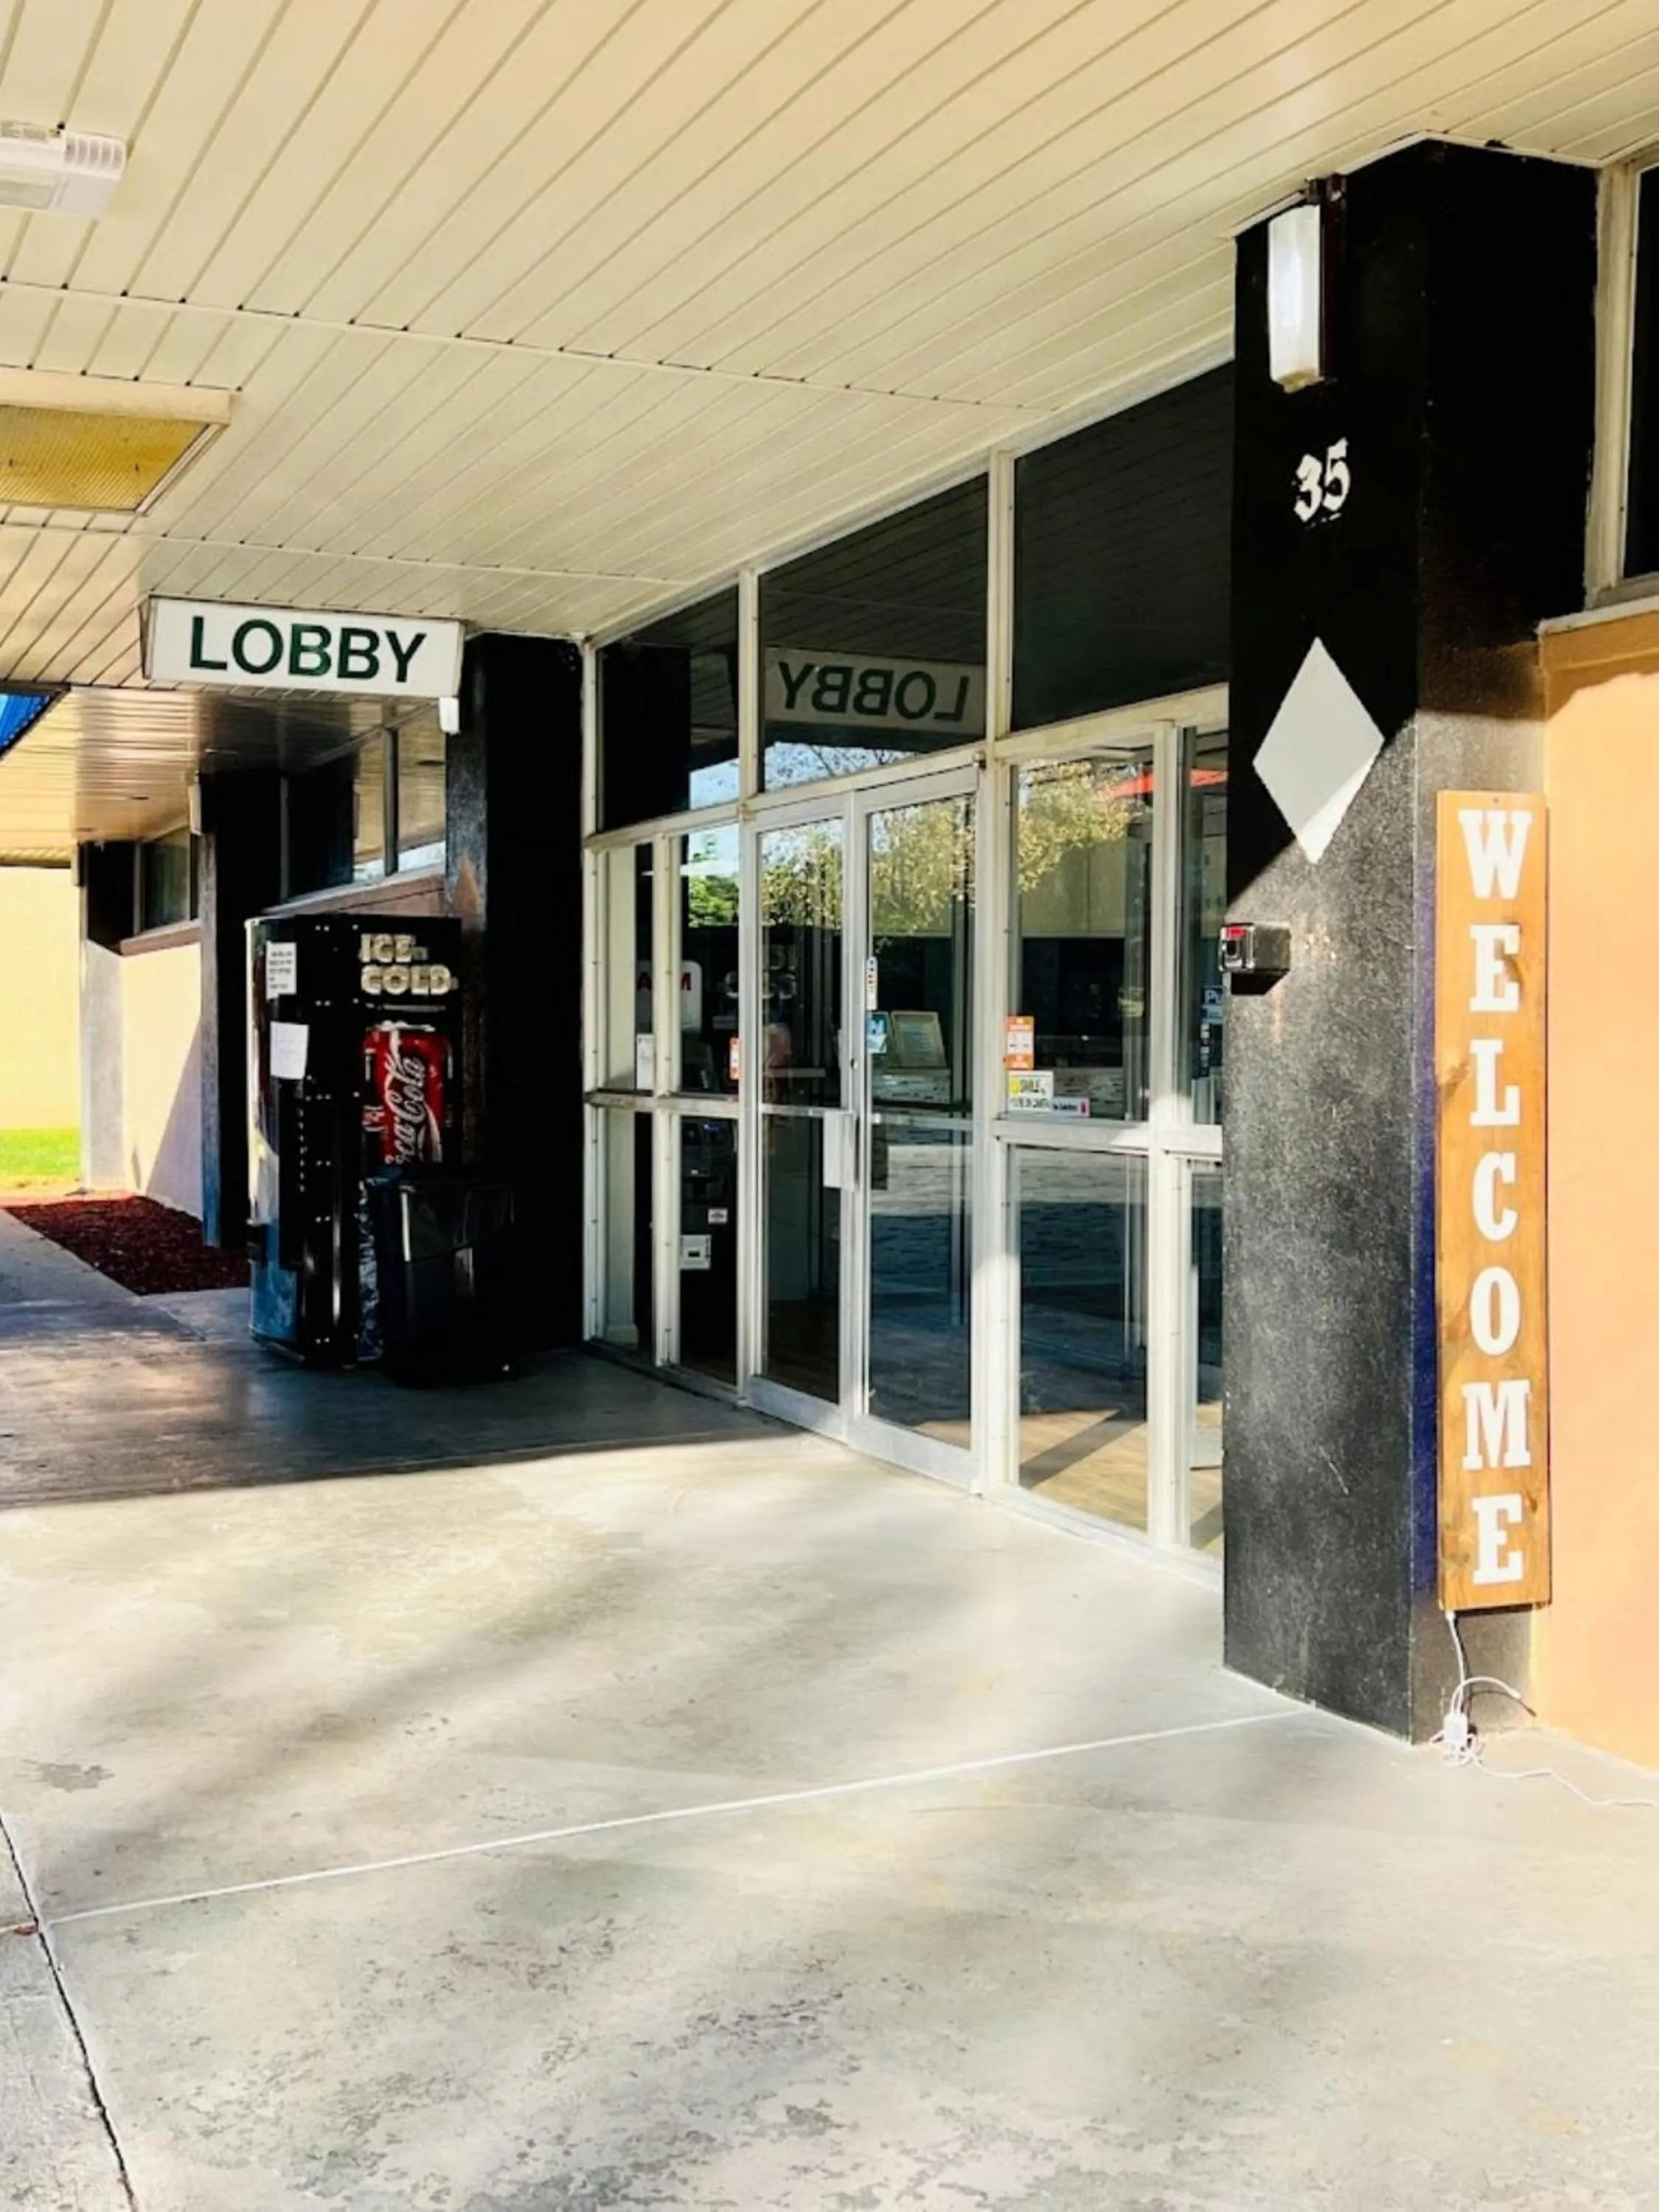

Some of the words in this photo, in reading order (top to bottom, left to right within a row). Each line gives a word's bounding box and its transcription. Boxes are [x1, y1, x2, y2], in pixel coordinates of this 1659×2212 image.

[1293, 437, 1351, 522] 35
[189, 616, 428, 684] LOBBY
[360, 964, 451, 995] COLD
[636, 971, 692, 991] AM
[1458, 808, 1533, 1584] WELCOME
